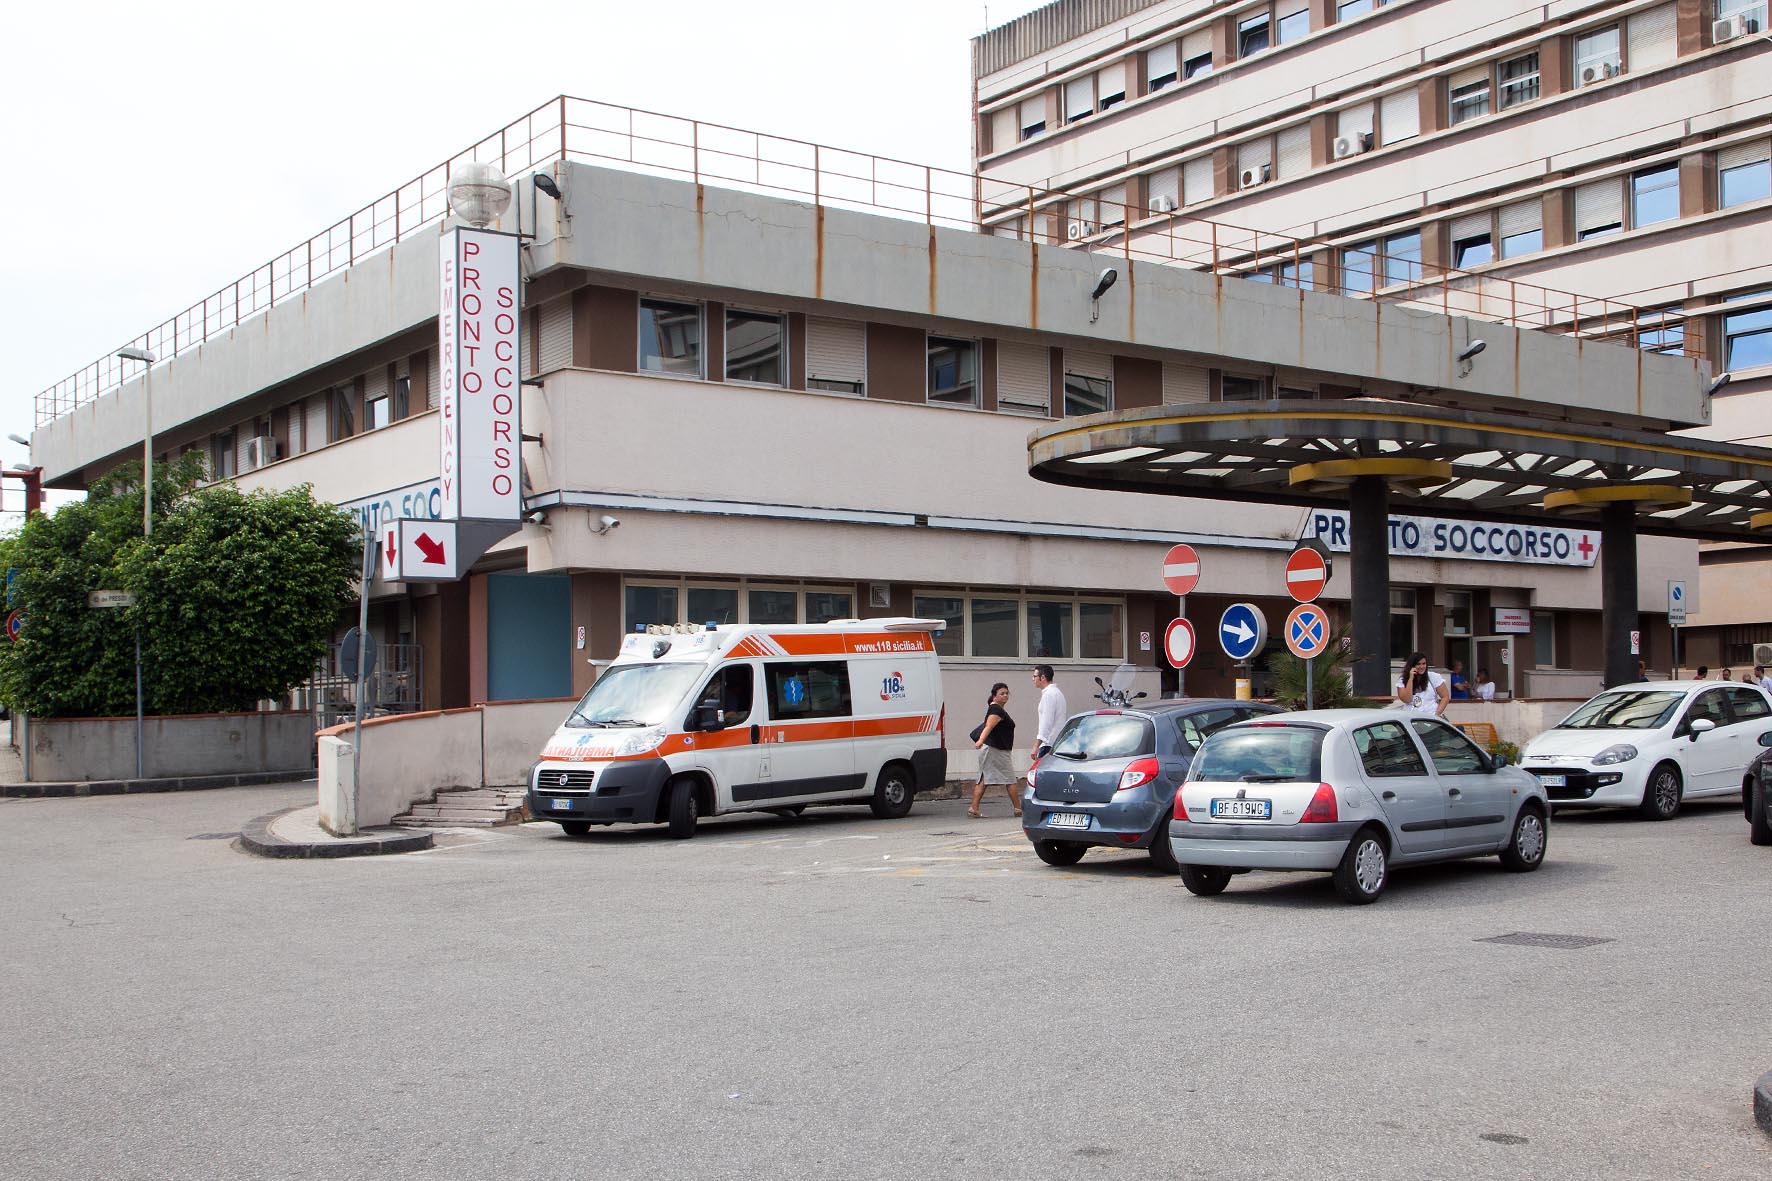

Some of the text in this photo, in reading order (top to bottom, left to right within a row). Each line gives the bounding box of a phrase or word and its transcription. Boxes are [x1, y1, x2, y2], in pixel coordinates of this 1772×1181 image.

[462, 242, 482, 394] PRONTO
[444, 260, 453, 501] EMERGENCY
[493, 287, 514, 495] SOCCORSO
[1315, 514, 1570, 560] PRTO SOCCORSO
[854, 640, 923, 652] www.118 sicilia.it
[883, 677, 900, 694] 118
[1218, 802, 1230, 814] BF
[1232, 803, 1263, 815] 619WG
